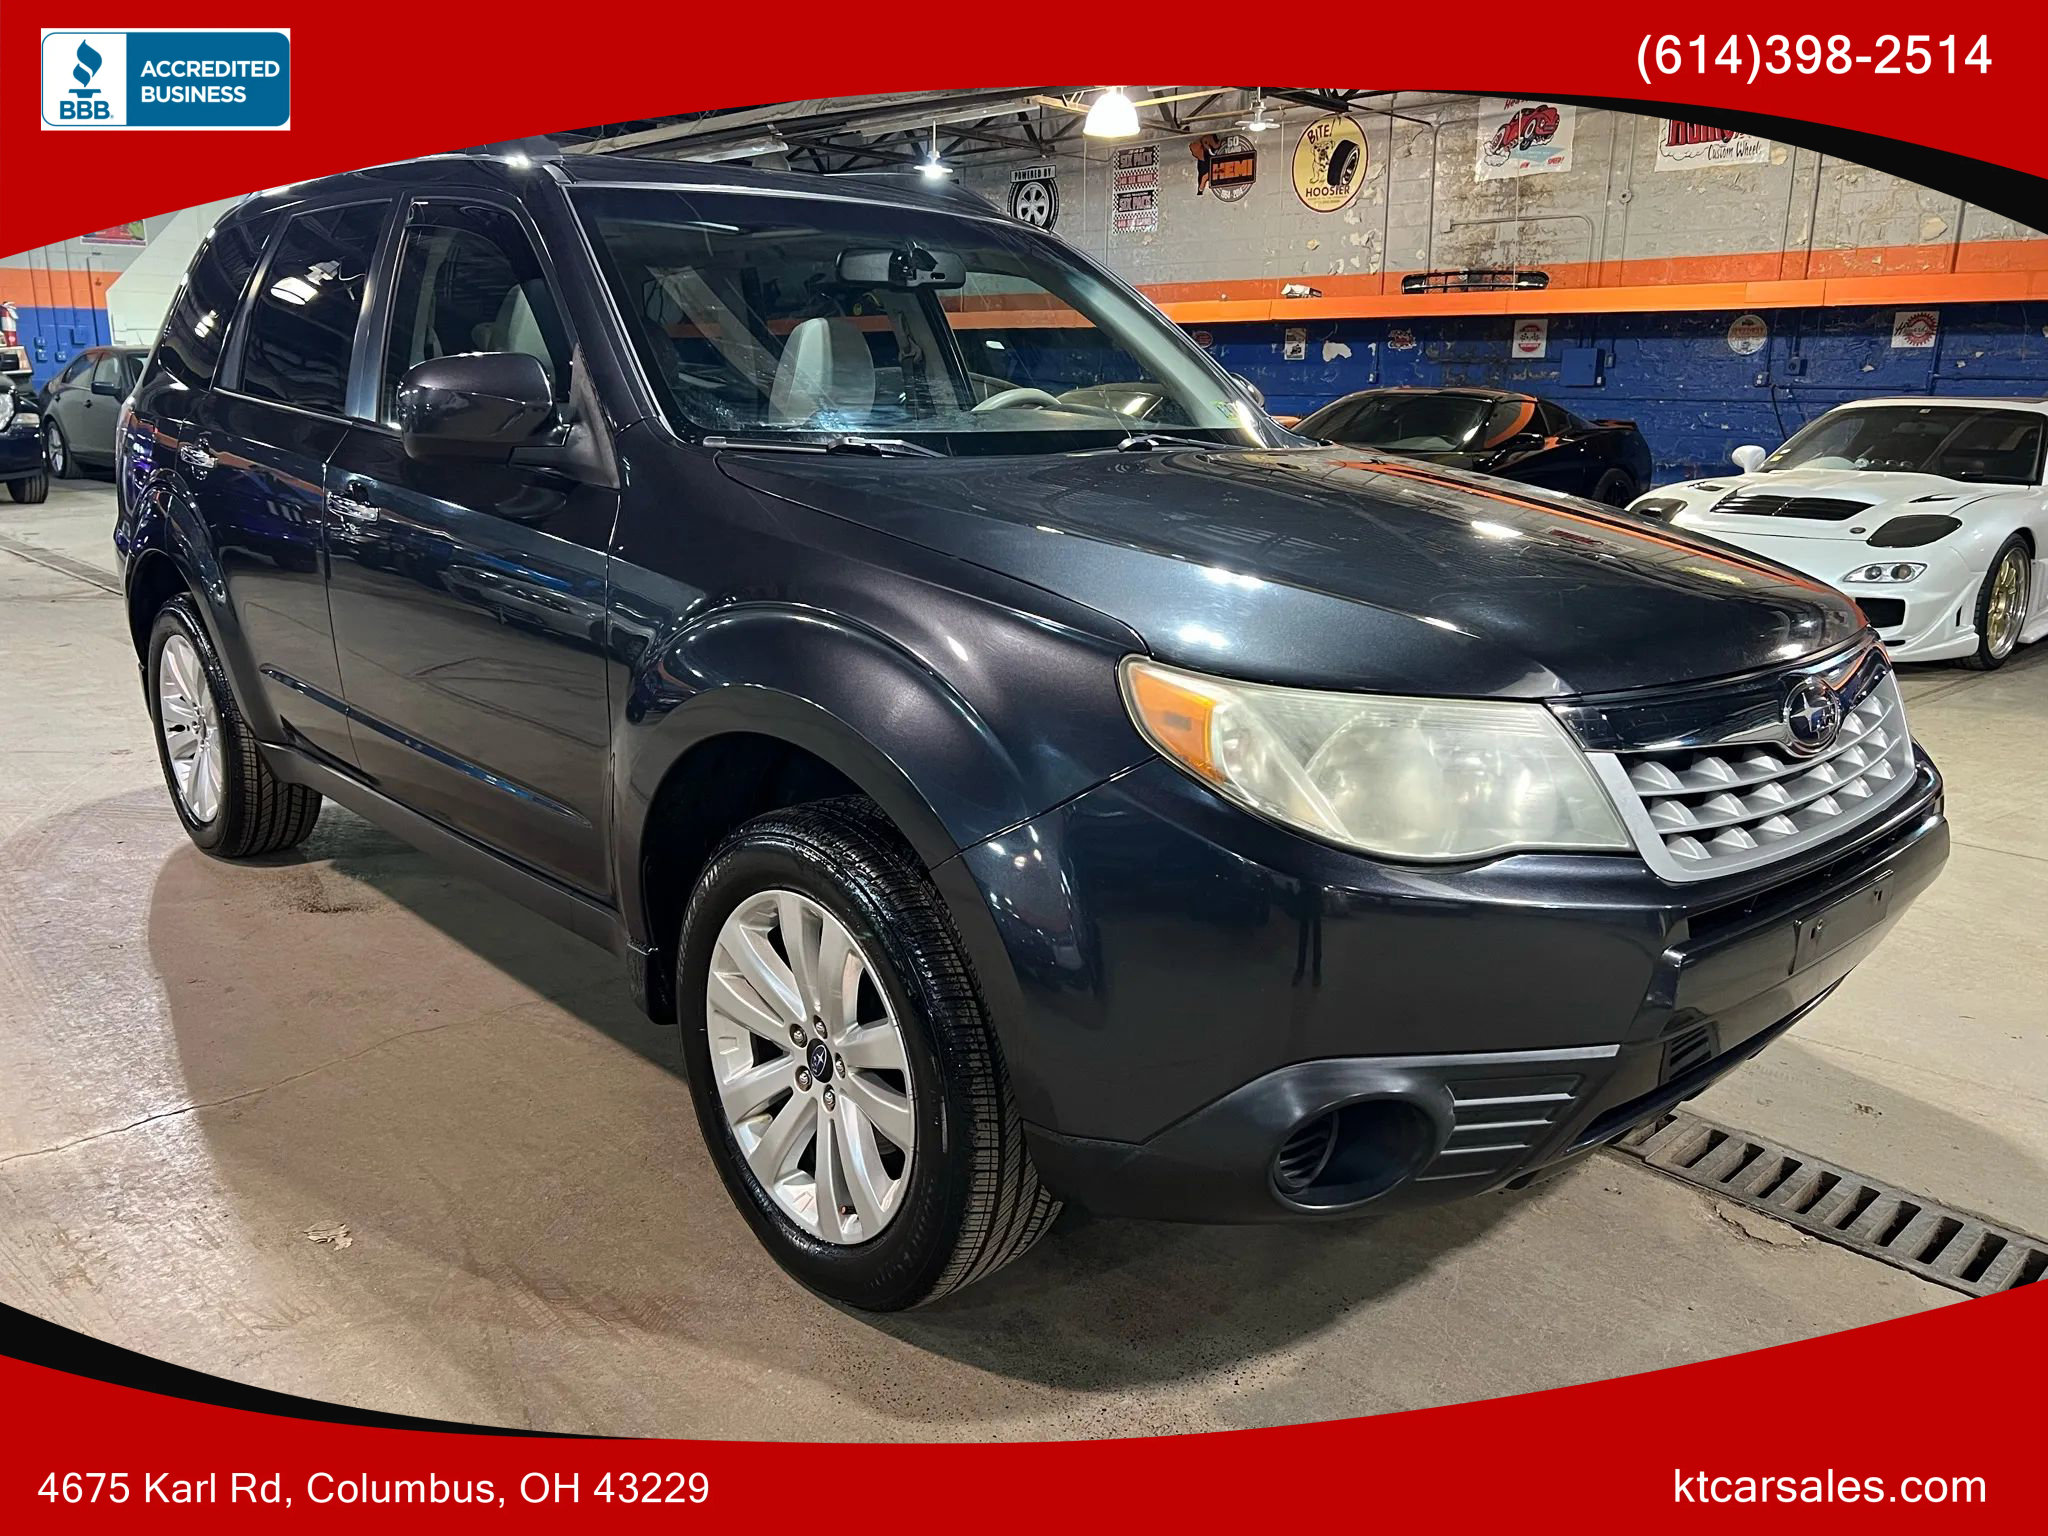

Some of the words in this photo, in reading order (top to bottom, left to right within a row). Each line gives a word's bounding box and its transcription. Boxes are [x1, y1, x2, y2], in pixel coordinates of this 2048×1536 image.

[1014, 169, 1042, 181] POWERED
[1043, 167, 1052, 178] BY
[1212, 159, 1253, 181] HEMI
[1306, 184, 1350, 197] HOOSIER
